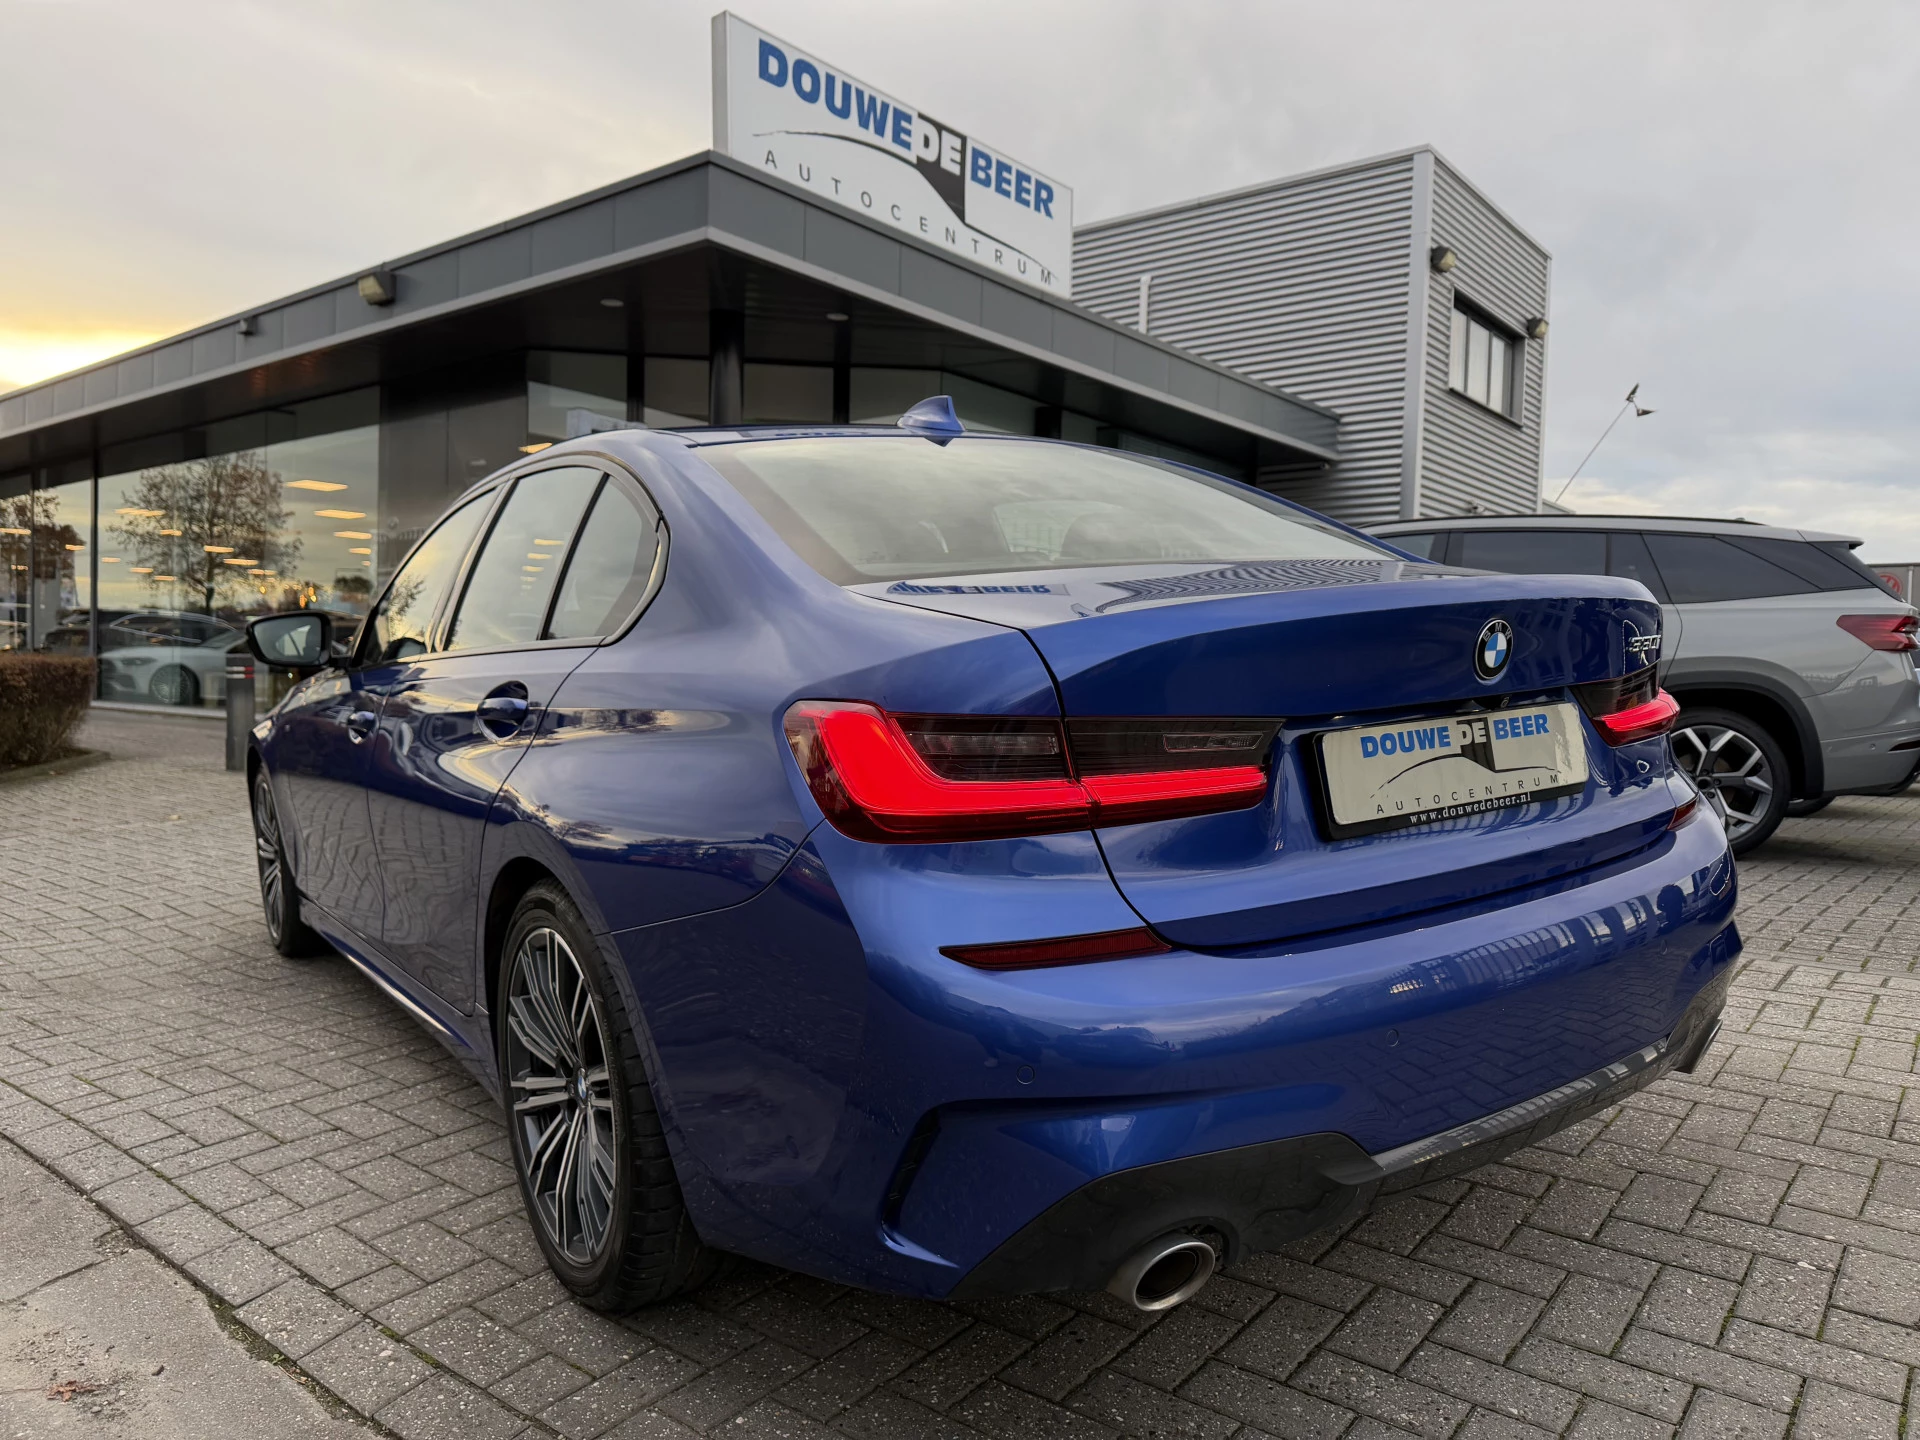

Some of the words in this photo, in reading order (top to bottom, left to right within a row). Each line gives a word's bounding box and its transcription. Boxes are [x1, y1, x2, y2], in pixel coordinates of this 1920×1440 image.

[971, 146, 1054, 219] BEER
[765, 150, 1051, 285] AUTOCENTRUM
[1360, 725, 1451, 759] DOUWE
[1460, 722, 1487, 746] DE
[1494, 713, 1550, 741] BEER
[1376, 774, 1559, 815] AUTOCENTRUM
[1410, 792, 1531, 824] www.douwedebeer.nl
